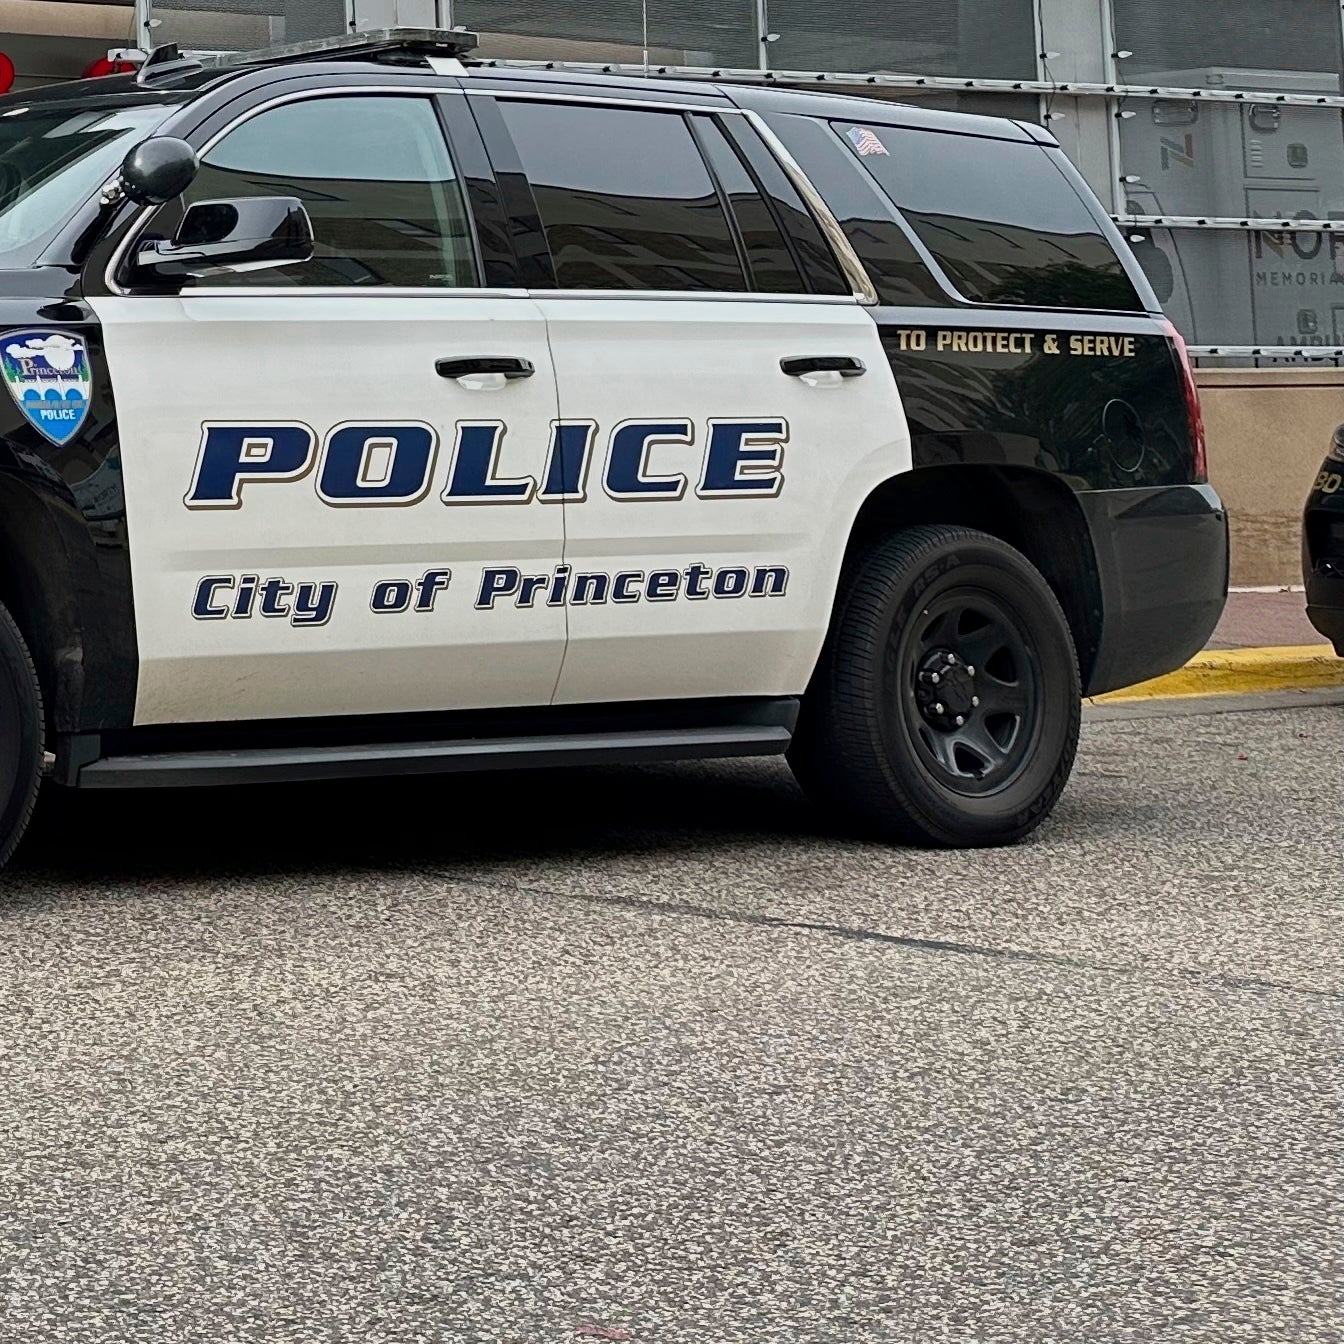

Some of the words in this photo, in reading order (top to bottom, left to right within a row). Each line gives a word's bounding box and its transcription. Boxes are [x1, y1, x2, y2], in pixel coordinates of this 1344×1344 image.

[896, 329, 927, 351] TO
[936, 330, 1035, 354] PROTECT
[1043, 334, 1060, 355] &
[1069, 335, 1135, 356] SERVE
[40, 409, 77, 421] POLICE
[182, 415, 790, 510] POLICE
[190, 573, 338, 629] City
[369, 567, 453, 616] of
[472, 562, 791, 611] Princeton
